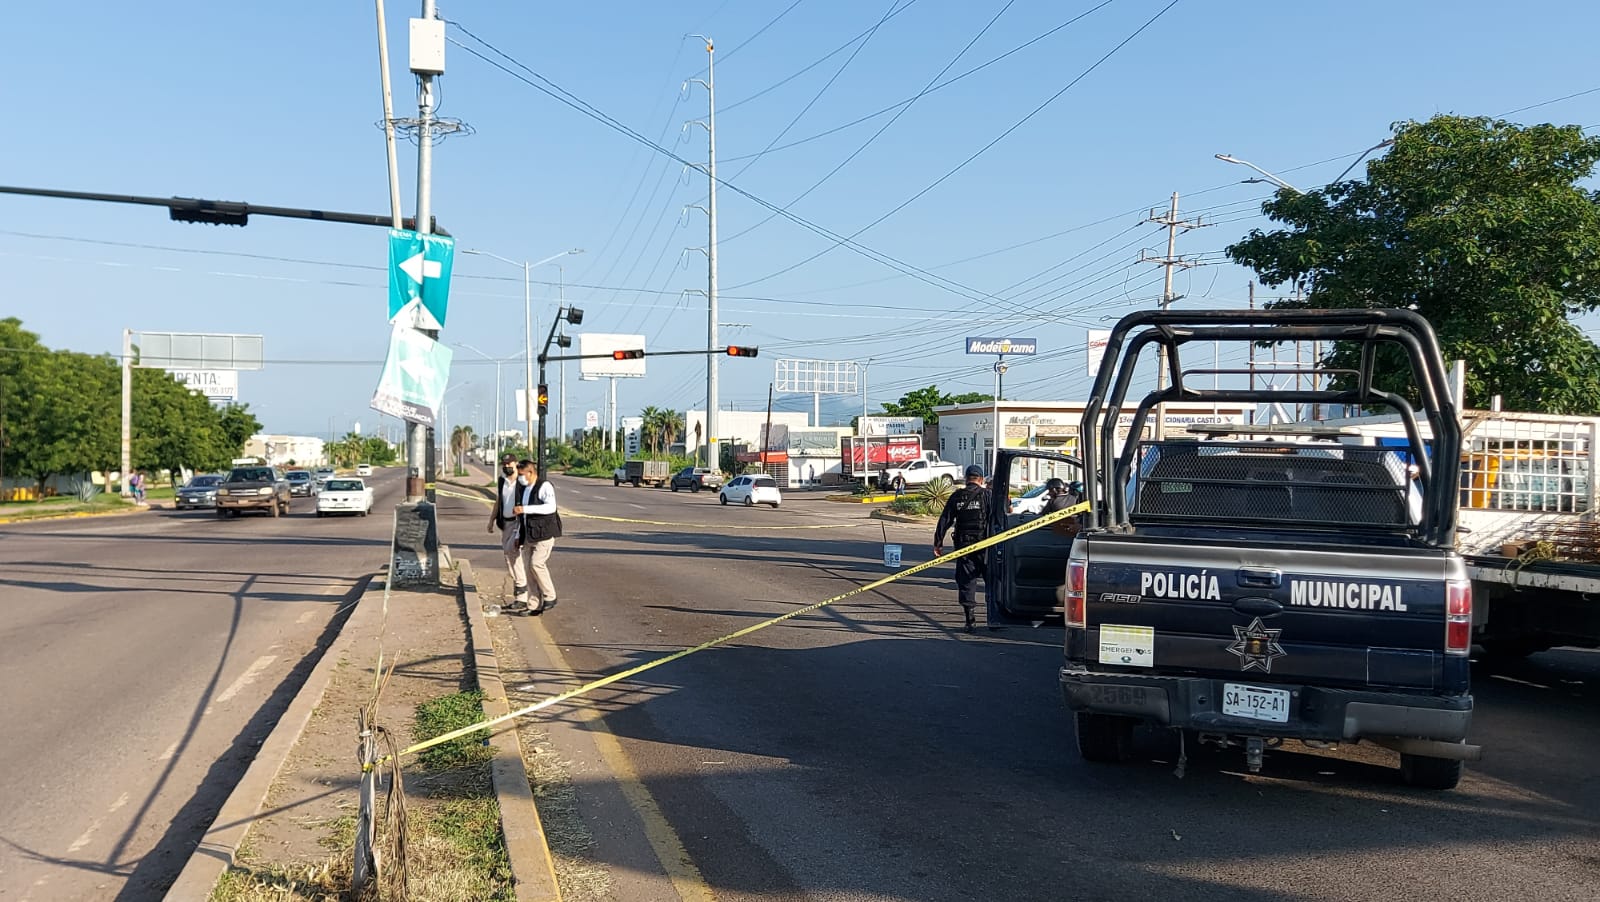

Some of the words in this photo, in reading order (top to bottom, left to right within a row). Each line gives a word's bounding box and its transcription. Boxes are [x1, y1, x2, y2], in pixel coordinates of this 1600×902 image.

[969, 339, 1035, 354] Modelorama
[1141, 570, 1221, 602] POLICÍA
[1290, 580, 1408, 612] MUNICIPAL
[1226, 691, 1285, 712] SA-152-A1
